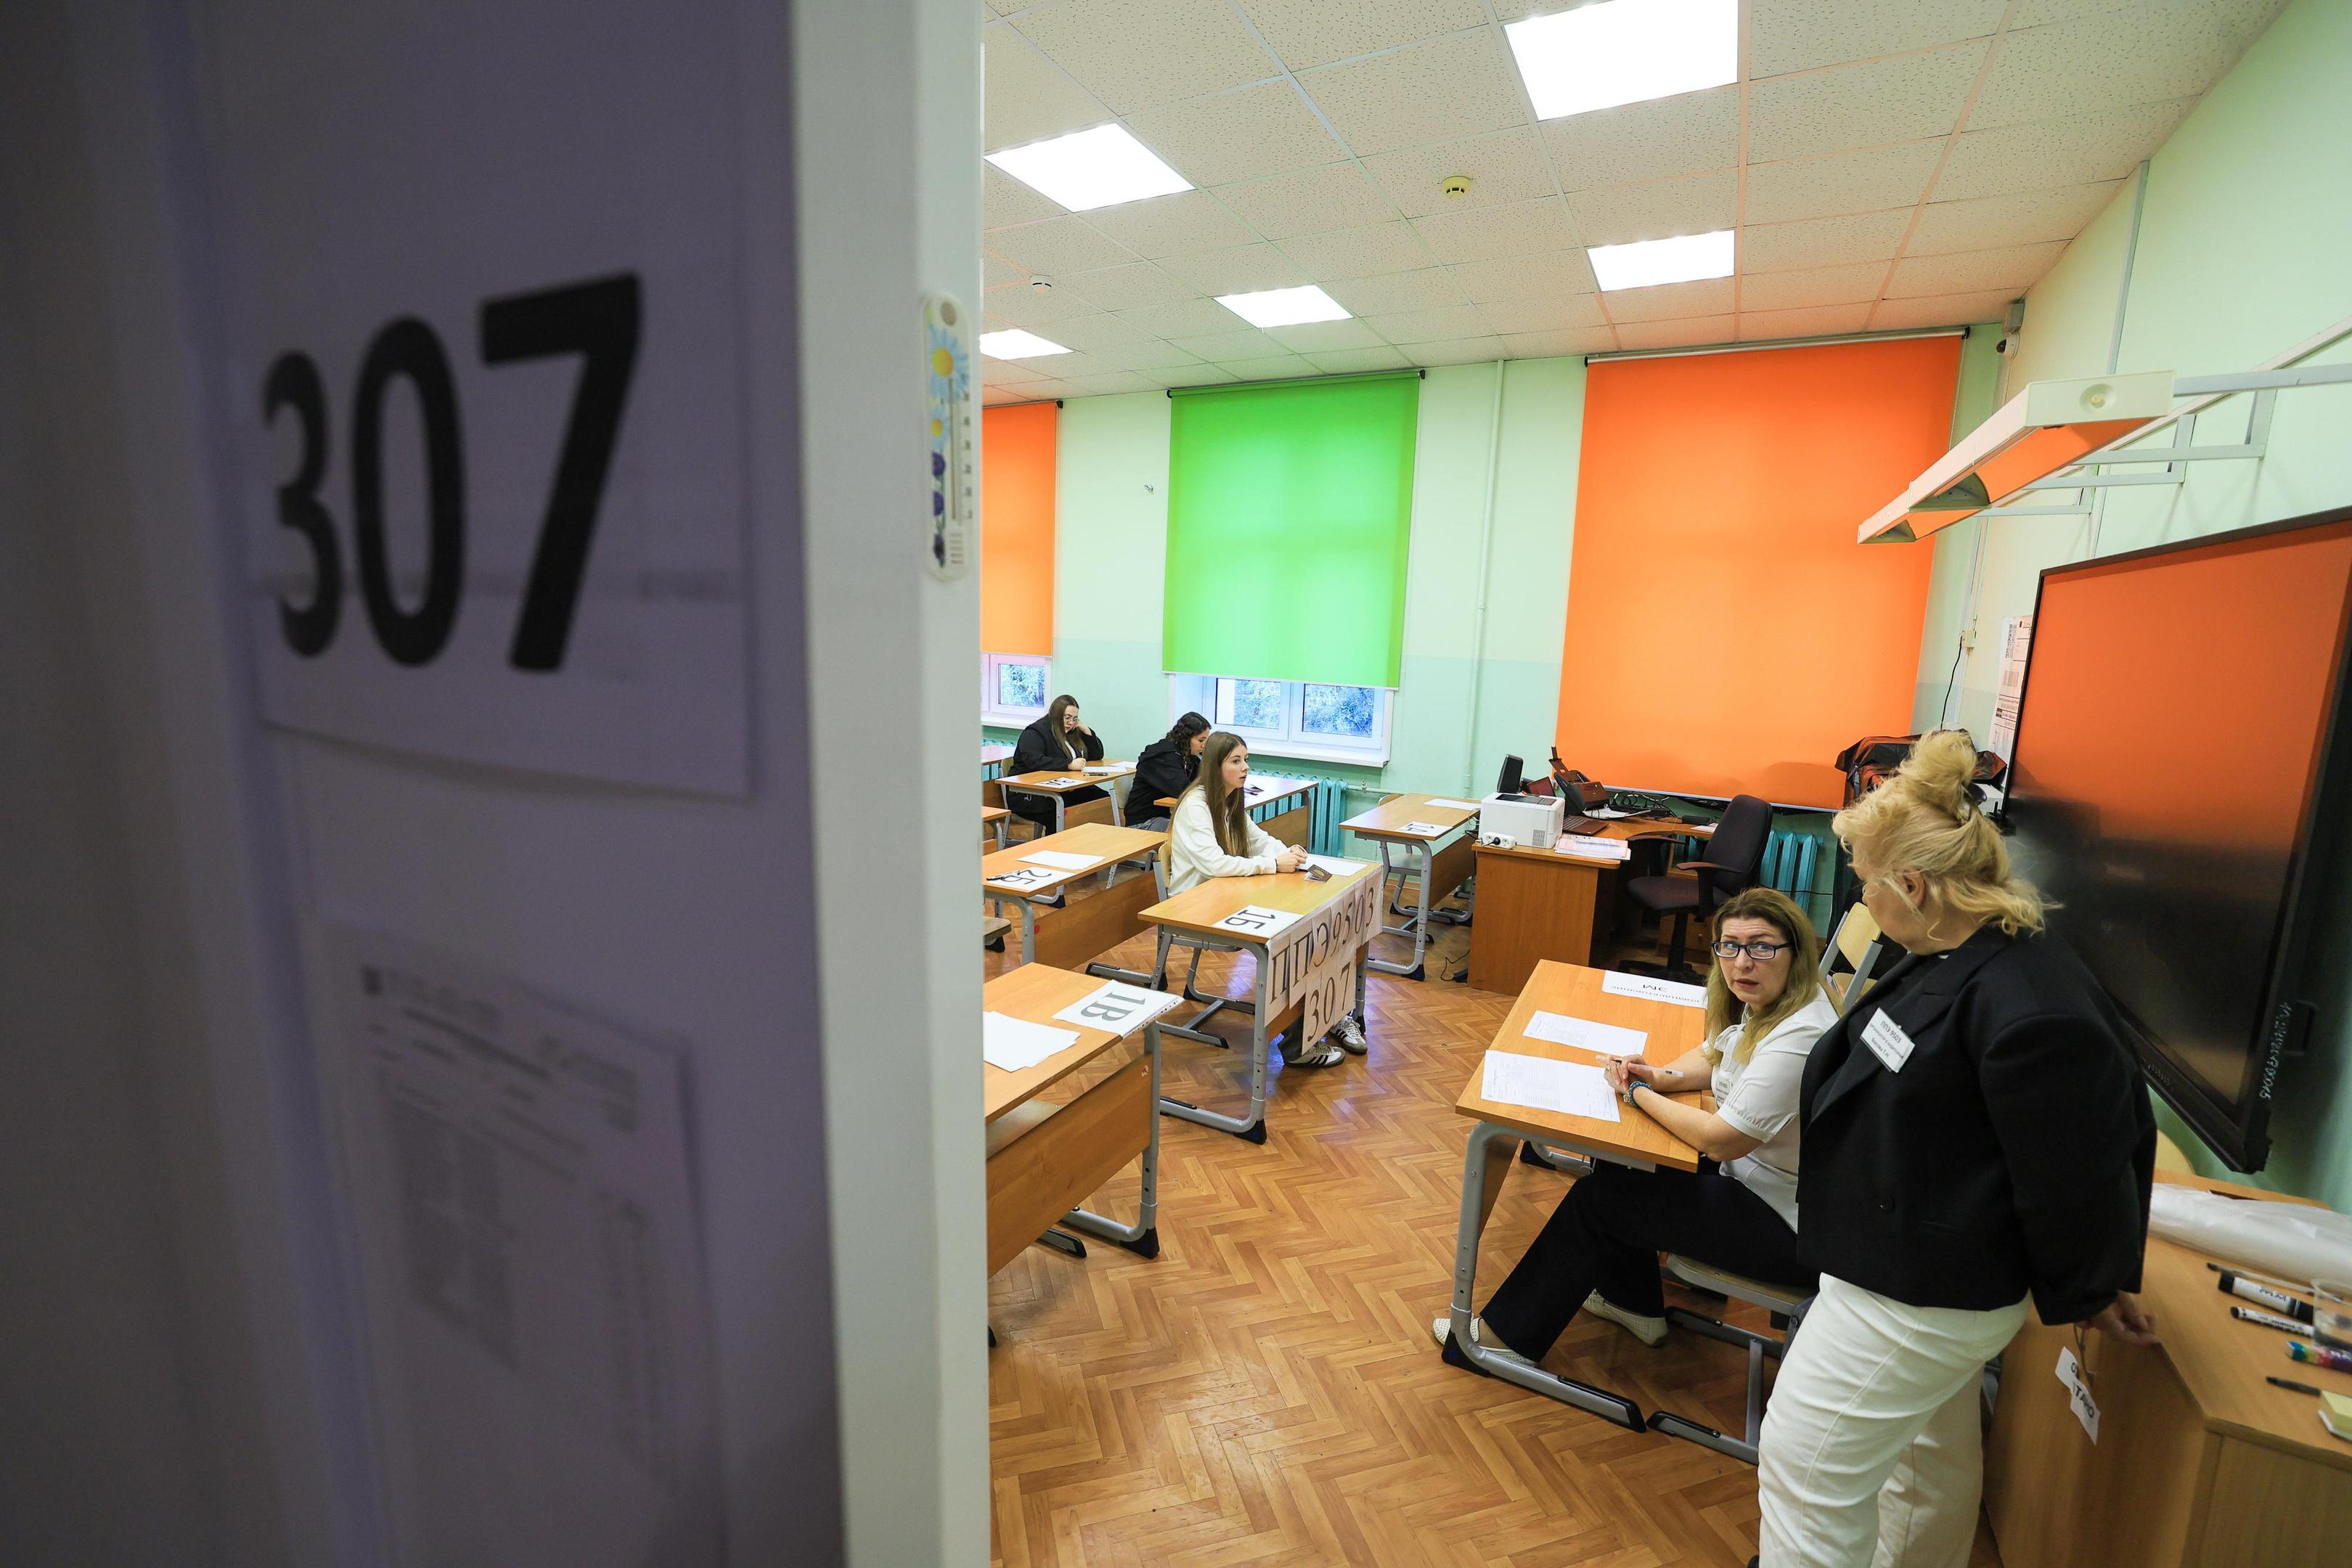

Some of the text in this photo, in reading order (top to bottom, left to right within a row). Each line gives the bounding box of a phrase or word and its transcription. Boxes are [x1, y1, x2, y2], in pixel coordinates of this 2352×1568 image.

[262, 269, 642, 672] 307
[1224, 910, 1275, 929] 1Б
[1307, 961, 1351, 1042] 307
[1880, 1021, 1902, 1043] ППЭ 9503
